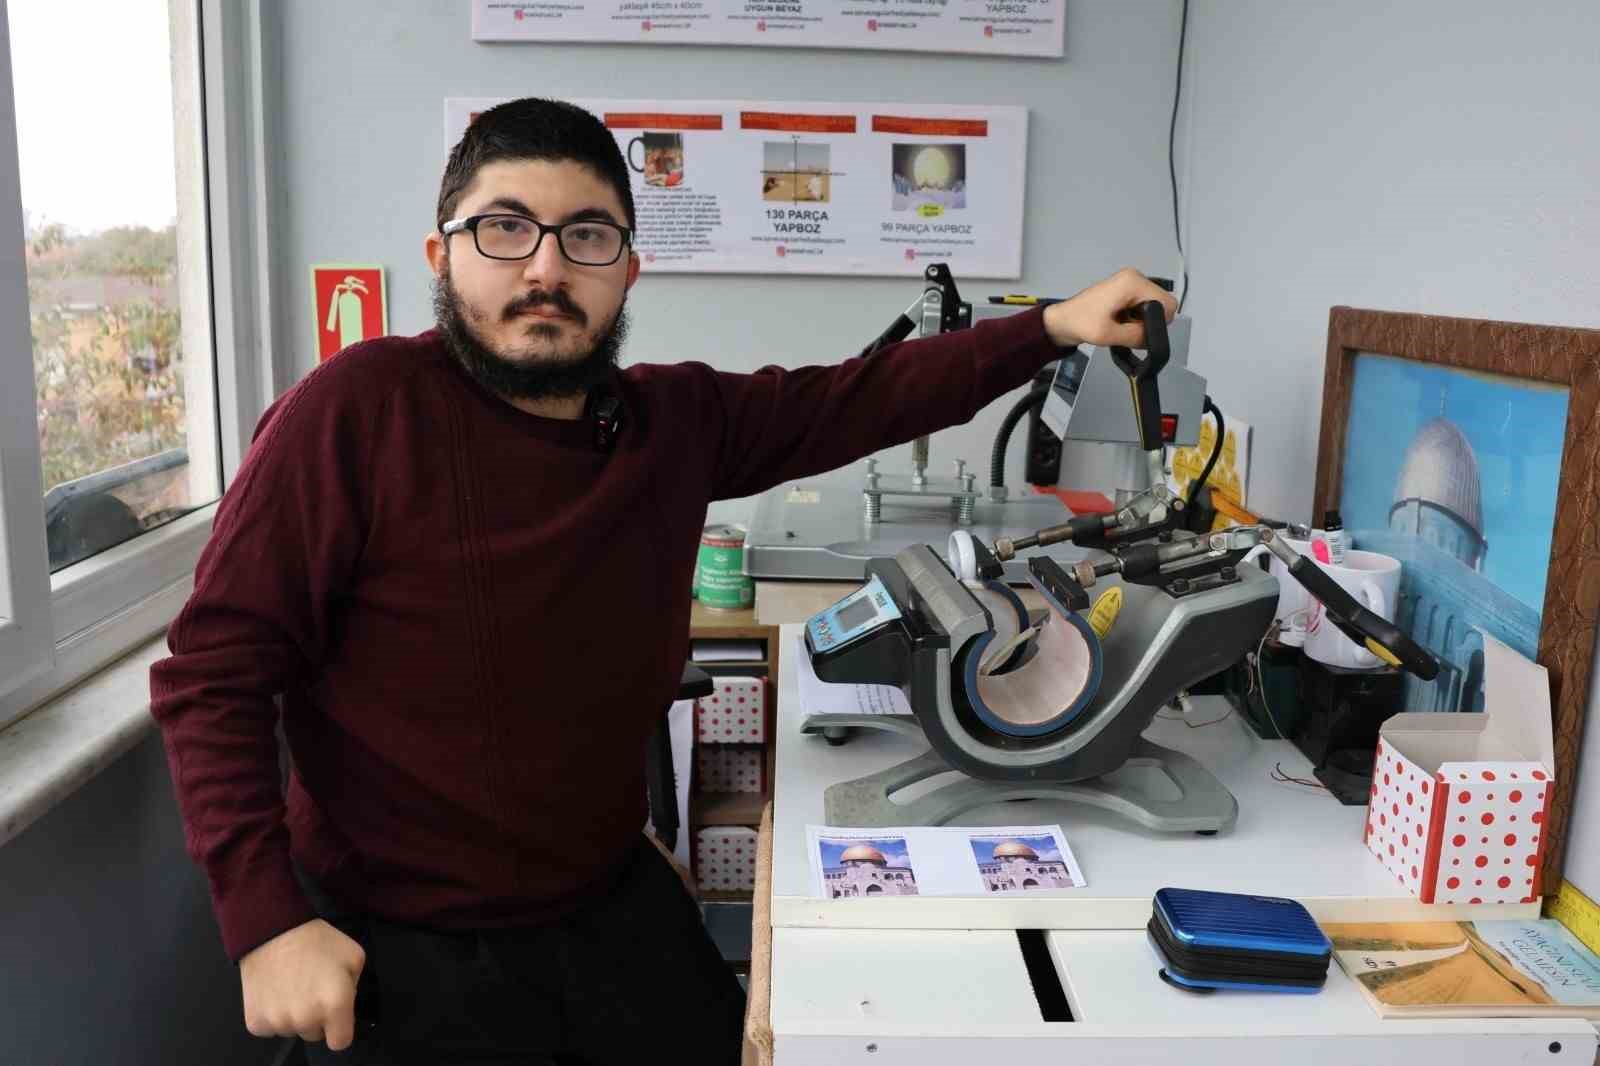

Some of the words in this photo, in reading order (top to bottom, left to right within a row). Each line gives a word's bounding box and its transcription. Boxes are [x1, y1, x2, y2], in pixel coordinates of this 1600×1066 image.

[775, 5, 802, 13] BEYAZ
[985, 4, 1027, 13] YAPBOZ
[765, 209, 785, 219] 130
[788, 209, 829, 221] PARÇA
[774, 223, 821, 233] YAPBOZ
[881, 222, 893, 231] 99
[895, 223, 930, 234] PARÇA
[932, 224, 973, 234] YAPBOZ
